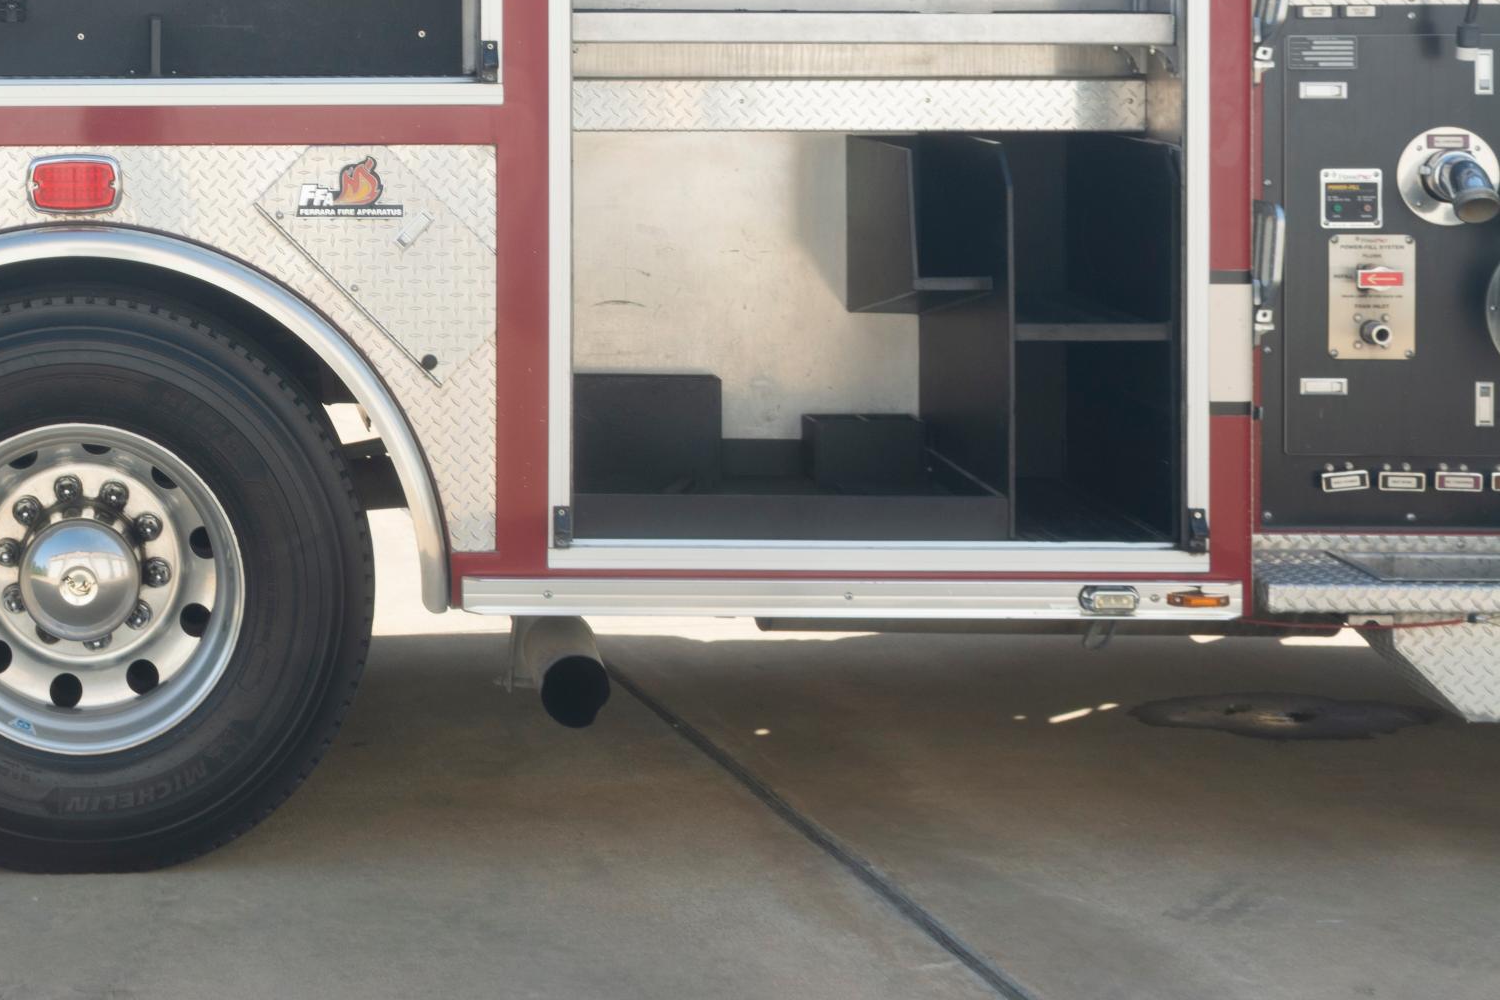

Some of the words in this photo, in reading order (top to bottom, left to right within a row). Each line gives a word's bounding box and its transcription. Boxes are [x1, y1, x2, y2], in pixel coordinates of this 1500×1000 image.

[300, 208, 336, 216] FERRARA
[337, 208, 355, 216] FIRE
[357, 208, 402, 216] APPARATUS
[66, 762, 207, 812] MICHELIN
